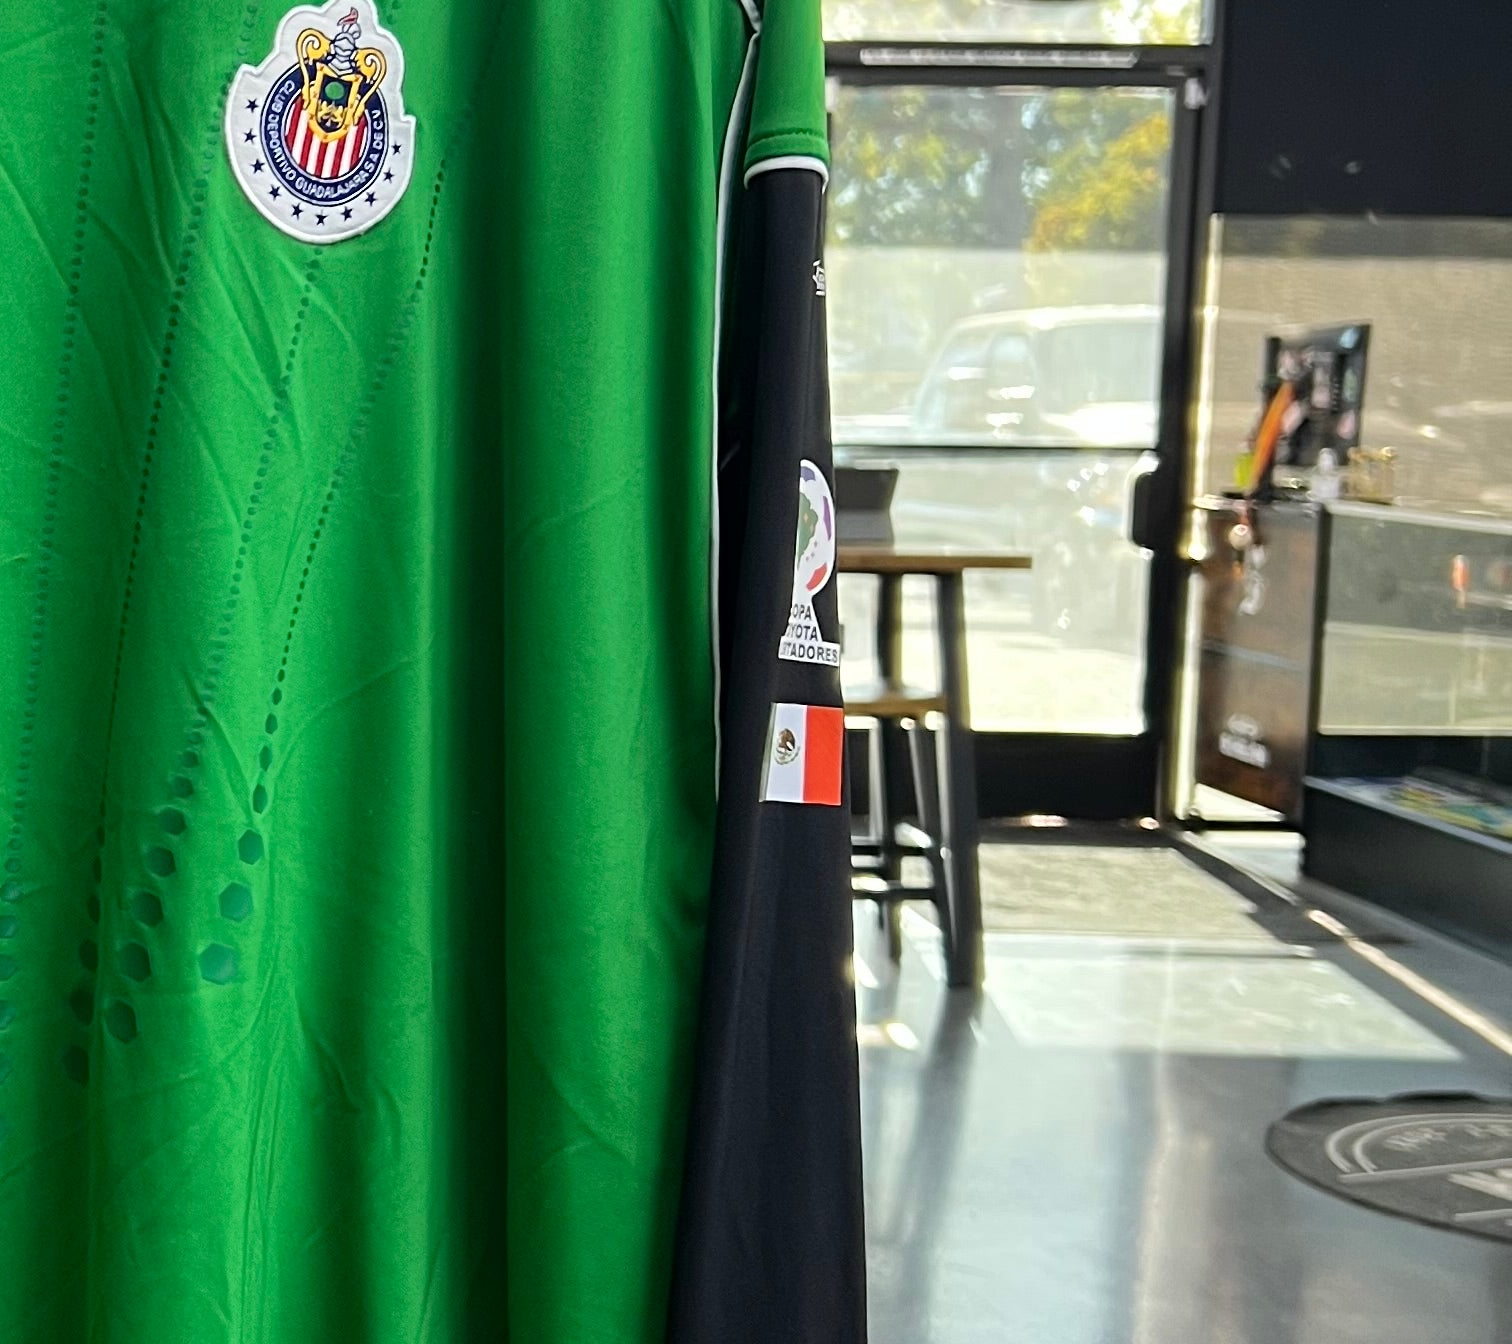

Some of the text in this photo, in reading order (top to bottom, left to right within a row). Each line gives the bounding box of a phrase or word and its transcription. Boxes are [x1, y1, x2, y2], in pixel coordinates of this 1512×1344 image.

[271, 79, 295, 113] CLUB
[267, 113, 297, 181] DEPORTIVO
[294, 170, 370, 199] GUADALAJARA
[791, 603, 812, 621] OPA
[785, 623, 819, 642] YOTA
[781, 641, 838, 663] TADORES
